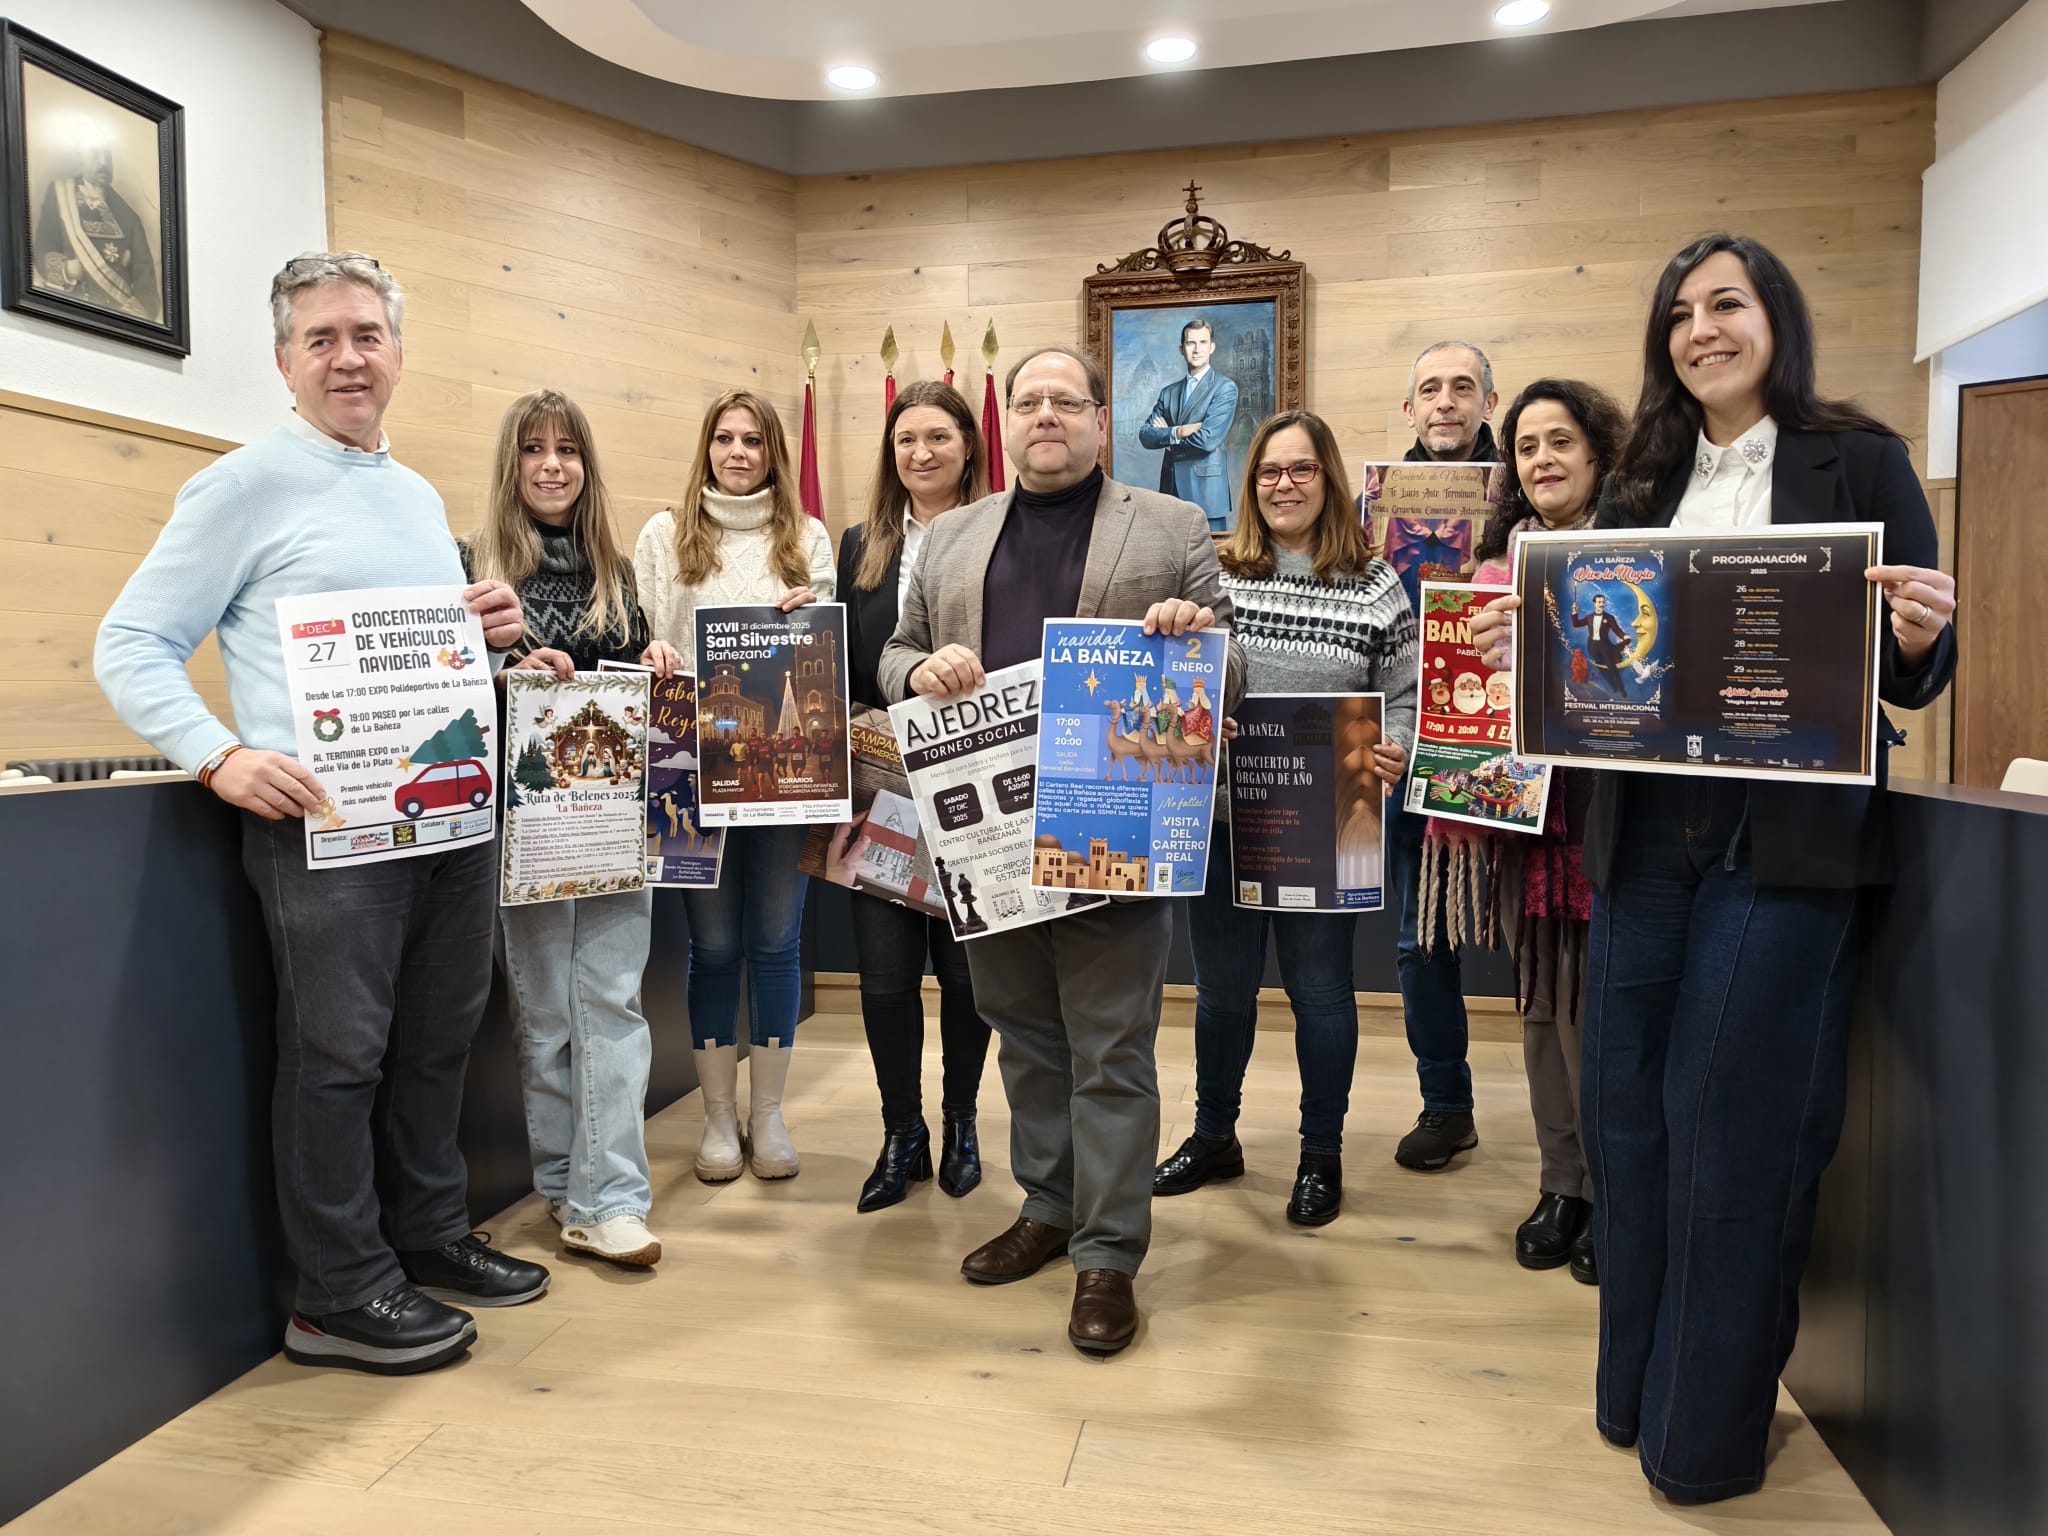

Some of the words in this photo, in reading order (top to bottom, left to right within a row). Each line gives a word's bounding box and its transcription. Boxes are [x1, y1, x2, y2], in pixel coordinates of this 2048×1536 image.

[1605, 556, 1636, 564] BAÑEZA
[1711, 553, 1807, 566] PROGRAMACIÓN
[1614, 563, 1656, 585] Magia
[1735, 585, 1747, 593] 26
[352, 603, 466, 629] CONCENTRACIÓN
[1735, 607, 1747, 616] 27
[306, 623, 331, 635] DEC
[706, 622, 739, 634] XXVII
[740, 623, 749, 631] 31
[749, 622, 790, 631] diciembre
[790, 621, 811, 630] 2025
[355, 634, 376, 651] DE
[379, 628, 456, 649] VEHÍCULOS
[706, 635, 737, 649] San
[740, 632, 814, 647] Silvestre
[1058, 627, 1126, 647] navidad
[1734, 640, 1746, 648] 28
[307, 641, 336, 663] 27
[706, 649, 772, 661] Bañezana
[1050, 648, 1073, 664] LA
[1077, 644, 1155, 667] BAÑEZA
[1185, 637, 1202, 659] 2
[359, 650, 431, 674] NAVIDEÑA
[1171, 660, 1214, 674] ENERO
[1733, 665, 1745, 673] 29
[305, 690, 330, 702] Desde
[332, 688, 345, 699] las
[346, 687, 366, 698] 17:00
[368, 685, 389, 696] EXPO
[390, 681, 440, 694] Polideportivo
[441, 679, 451, 689] de
[452, 678, 461, 688] La
[462, 676, 488, 687] Bañeza
[349, 713, 370, 723] 19:00
[372, 710, 397, 721] PASEO
[399, 709, 411, 720] por
[413, 707, 425, 716] las
[426, 705, 450, 715] calles
[907, 679, 1040, 748] AJEDREZ
[1564, 702, 1598, 710] FESTIVAL
[1599, 703, 1660, 712] INTERNACIONAL
[351, 725, 360, 734] de
[362, 724, 372, 733] La
[374, 721, 401, 732] Bañeza
[1056, 718, 1080, 727] 17:00
[1249, 722, 1286, 738] BAÑEZA
[1425, 720, 1445, 733] 17:00
[1447, 725, 1454, 734] A
[1457, 725, 1479, 735] 20:00
[1486, 724, 1497, 739] 4
[1065, 728, 1072, 736] A
[923, 737, 973, 762] TORNEO
[978, 721, 1027, 745] SOCIAL
[1054, 737, 1082, 746] 20:00
[313, 754, 324, 763] AL
[325, 749, 366, 762] TERMINAR
[368, 746, 389, 757] EXPO
[390, 746, 400, 755] en
[402, 744, 410, 753] la
[862, 744, 902, 763] COMERCIO
[314, 763, 335, 774] calle
[351, 760, 361, 770] de
[362, 759, 371, 768] la
[373, 757, 393, 768] Plata
[930, 767, 956, 780] Merienda
[956, 764, 968, 775] para
[968, 759, 984, 771] todos
[1011, 749, 1024, 760] para
[1024, 744, 1034, 753] los
[1235, 755, 1290, 770] CONCIERTO
[1292, 756, 1306, 771] DE
[712, 779, 740, 787] SALIDAS
[778, 777, 814, 785] HORARIOS
[1003, 777, 1014, 787] DE
[1014, 772, 1031, 784] 16:00
[1236, 769, 1274, 785] ÓRGANO
[1277, 772, 1290, 786] DE
[1293, 769, 1313, 786] AÑO
[340, 783, 363, 794] Premio
[1236, 786, 1268, 801] NUEVO
[525, 793, 550, 806] Ruta
[553, 791, 566, 803] de
[568, 790, 610, 803] Belenes
[610, 791, 635, 803] 2025
[943, 792, 969, 806] SABADO
[556, 804, 568, 813] La
[569, 803, 603, 813] Bañeza
[947, 805, 956, 814] 27
[956, 803, 968, 813] DIC
[952, 814, 968, 824] 2025
[1162, 816, 1200, 827] VISITA
[938, 834, 966, 848] CENTRO
[966, 825, 1004, 841] CULTURAL
[1004, 821, 1014, 830] DE
[1015, 817, 1030, 828] LAS
[977, 827, 1022, 846] BAÑEZANAS
[1170, 828, 1192, 839] DEL
[1152, 839, 1206, 850] CARTERO
[947, 856, 970, 869] GRATIS
[970, 852, 988, 863] PARA
[988, 845, 1014, 858] SOCIOS
[1015, 841, 1029, 851] DEL
[1165, 851, 1194, 862] REAL
